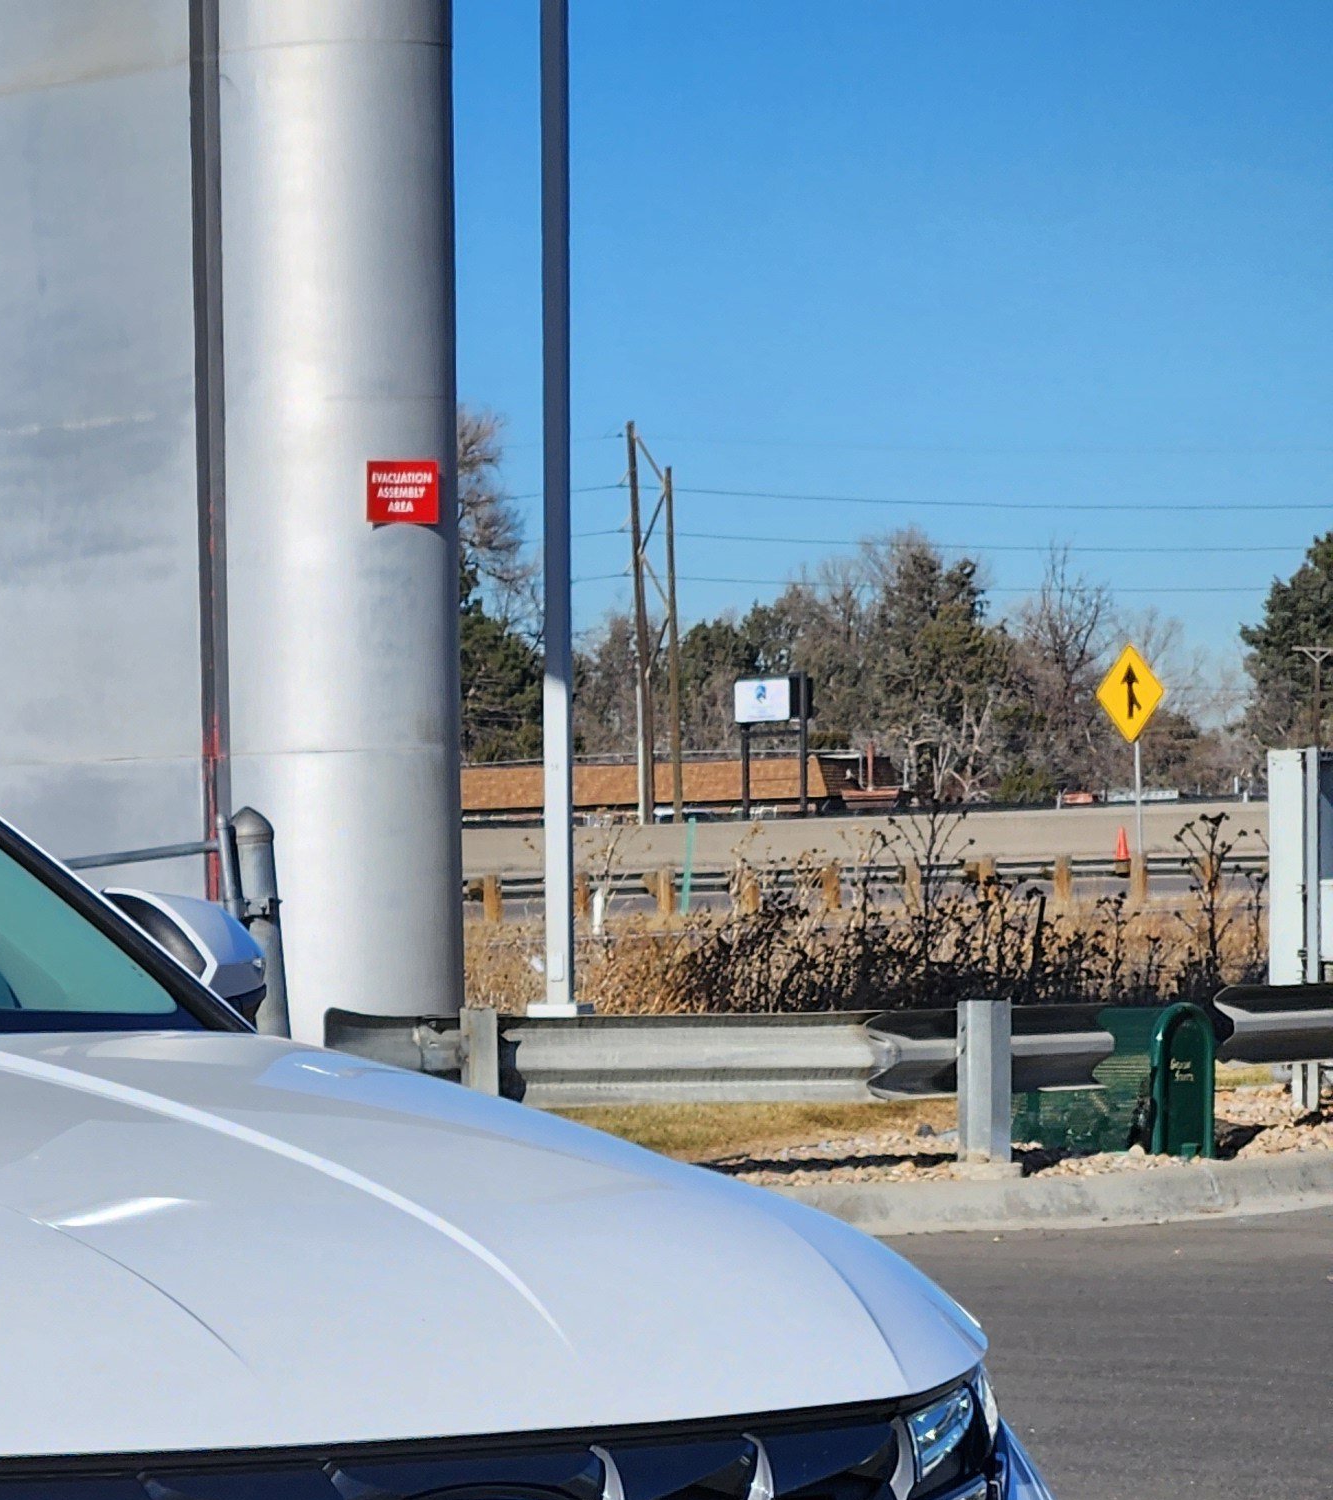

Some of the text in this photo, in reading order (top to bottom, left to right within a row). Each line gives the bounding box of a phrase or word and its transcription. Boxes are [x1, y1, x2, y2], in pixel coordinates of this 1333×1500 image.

[371, 471, 433, 484] EVACUATION
[377, 485, 426, 499] ASSEMBLY
[387, 500, 414, 513] AREA
